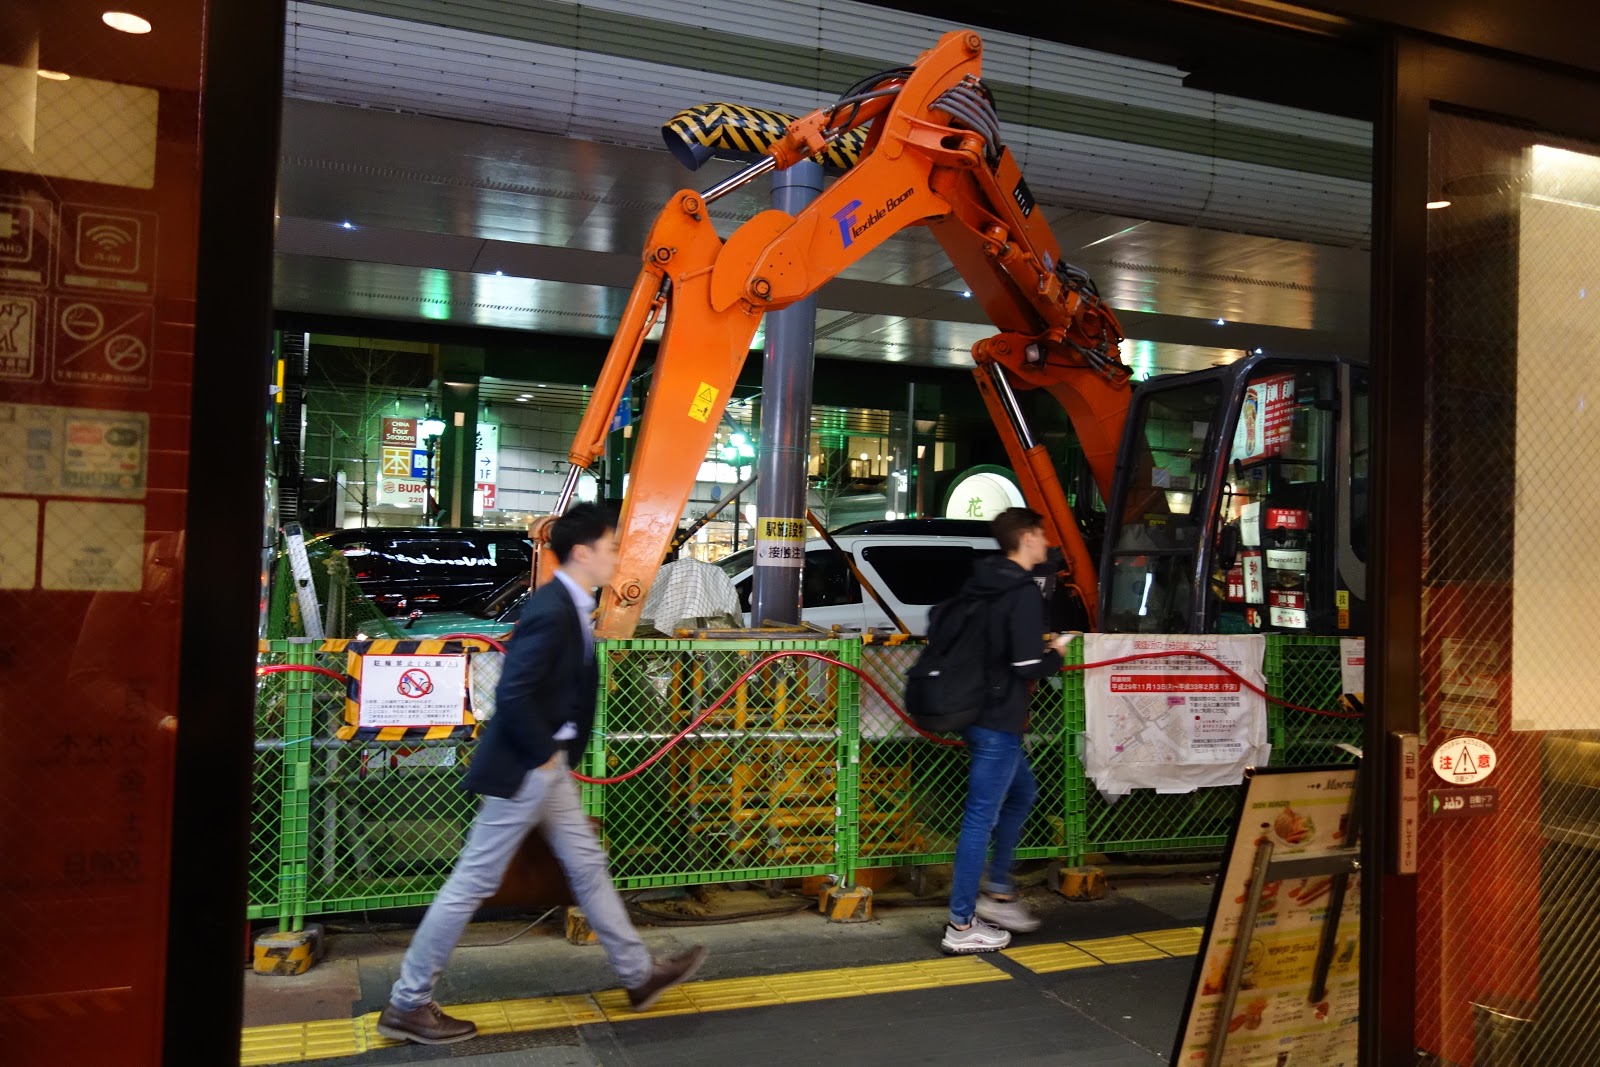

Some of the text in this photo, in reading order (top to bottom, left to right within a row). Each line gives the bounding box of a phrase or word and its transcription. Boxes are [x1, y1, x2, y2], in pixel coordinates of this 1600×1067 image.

[831, 187, 914, 250] Flexible Boom
[392, 427, 409, 435] Four
[386, 433, 415, 442] Seasons
[480, 469, 491, 479] 1F
[966, 496, 984, 518] 花
[768, 546, 805, 560] 接触注
[1440, 754, 1490, 770] 注 意
[1322, 779, 1354, 790] Morn
